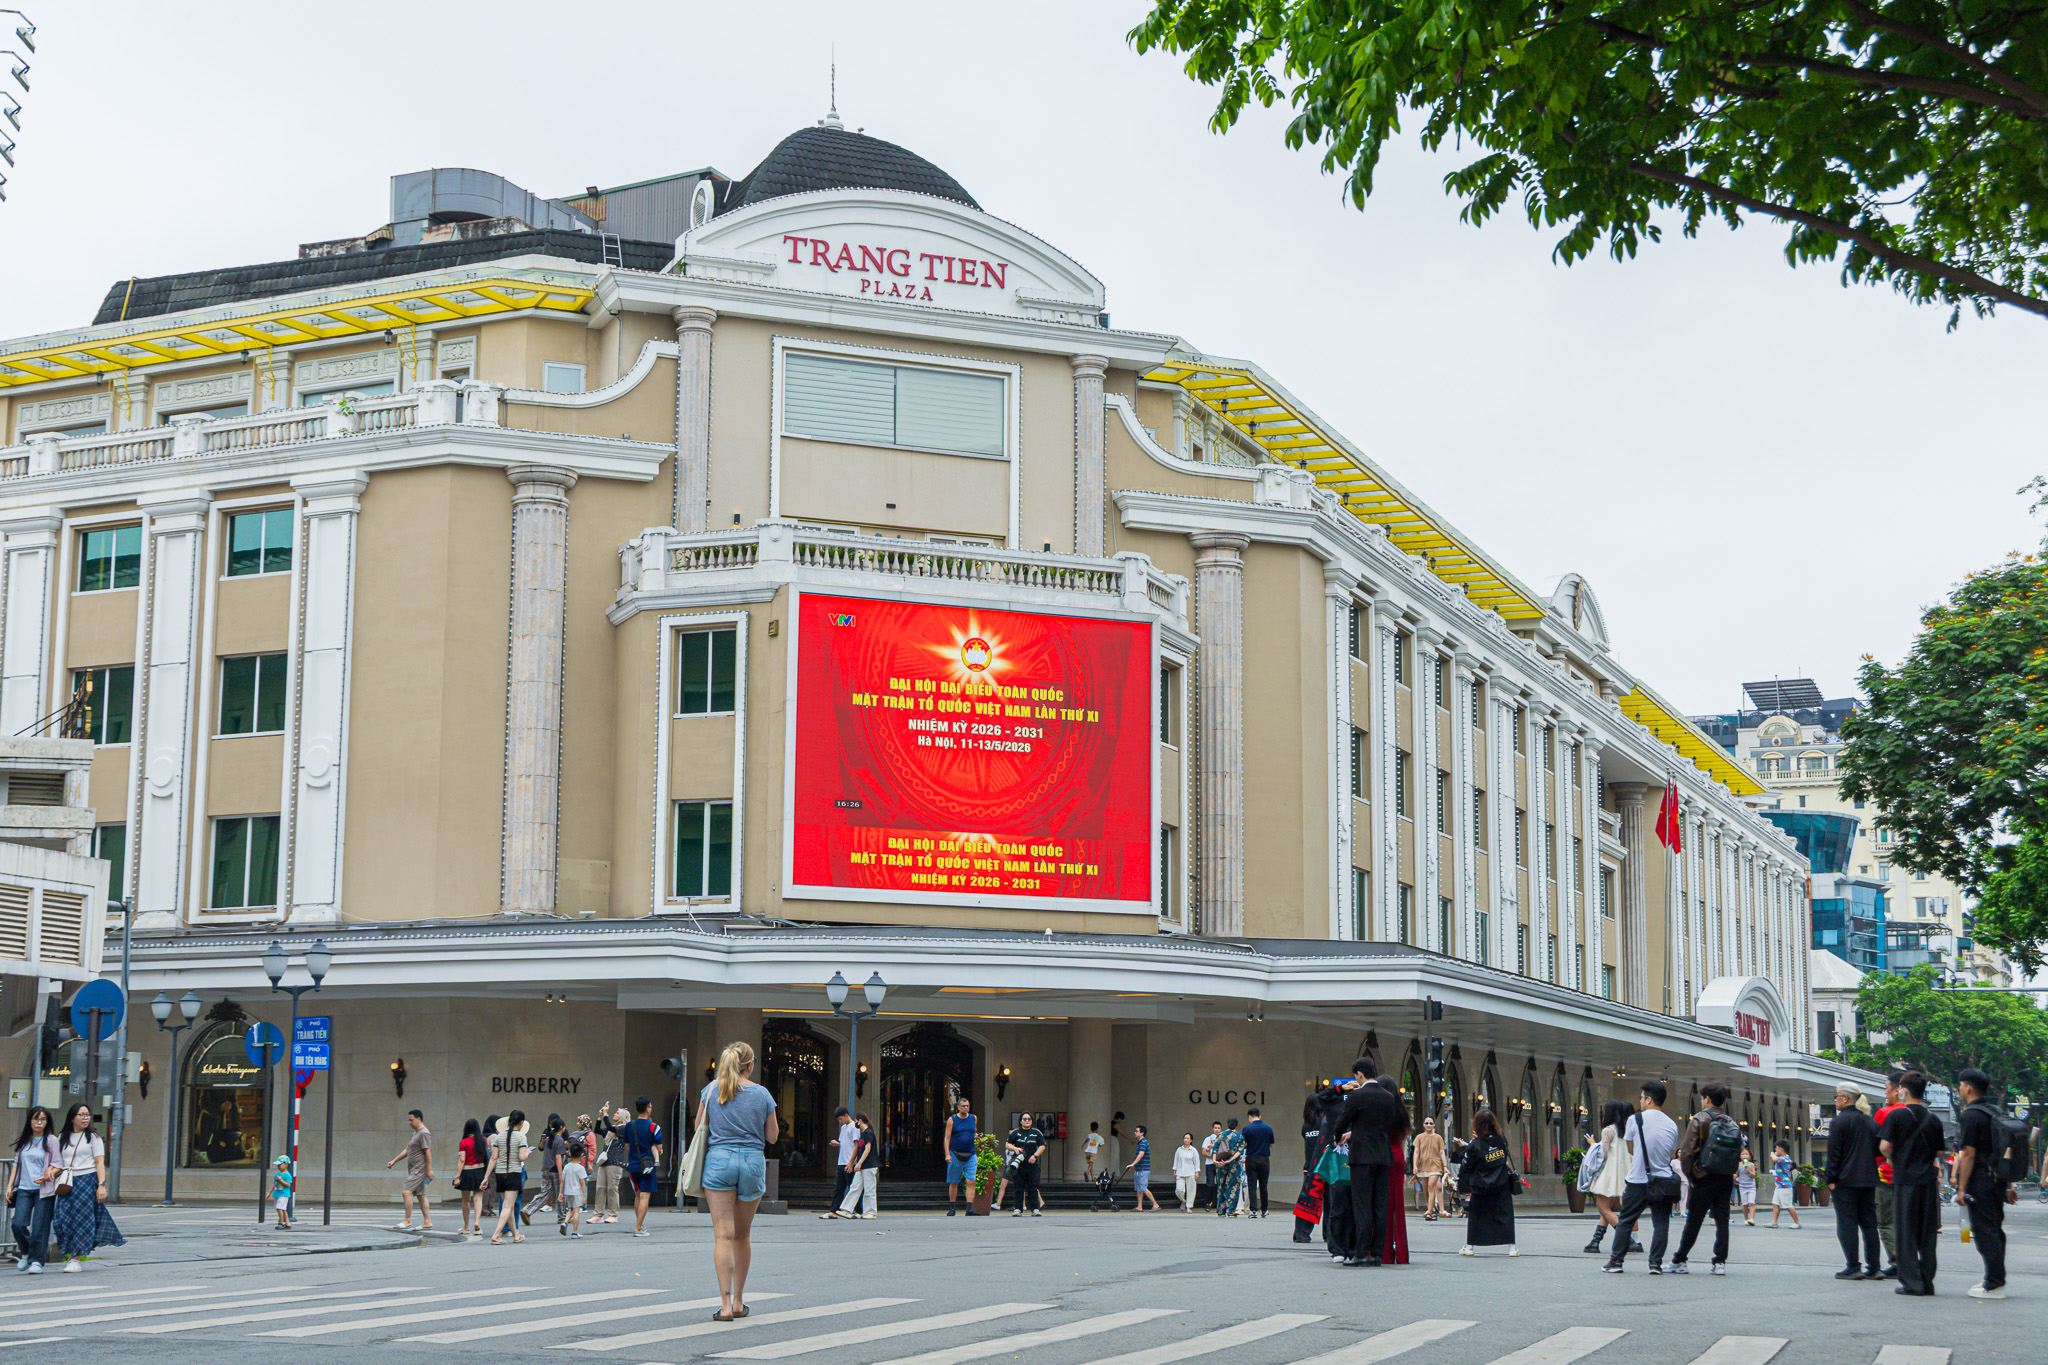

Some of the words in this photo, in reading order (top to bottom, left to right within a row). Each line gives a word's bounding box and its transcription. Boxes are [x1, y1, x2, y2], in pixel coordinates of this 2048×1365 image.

[783, 235, 911, 277] TRANG
[920, 253, 1008, 289] TIEN
[861, 279, 933, 301] PLAZA
[890, 677, 911, 692] ĐẠI
[914, 678, 936, 694] HỘI
[940, 681, 961, 695] ĐẠI
[966, 681, 992, 697] BIỂU
[997, 685, 1027, 699] TOÀN
[1032, 686, 1064, 702] QUỐC
[852, 692, 878, 708] MẶT
[882, 695, 914, 710] TRẬN
[918, 695, 933, 710] TỔ
[938, 698, 971, 713] QUỐC
[975, 702, 1001, 717] VIỆT
[1005, 705, 1031, 718] NAM
[1035, 704, 1056, 719] LẦN
[1060, 708, 1084, 721] THỨ
[1087, 710, 1098, 722] XI
[908, 718, 948, 733] NHIỆM
[952, 720, 968, 733] KỲ
[971, 723, 1001, 736] 2026
[1015, 726, 1043, 738] 2031
[918, 736, 931, 746] Hà
[935, 737, 956, 749] Nội,
[961, 739, 1031, 752] 11-13/5/2026
[888, 838, 909, 850] ĐẠI
[914, 838, 935, 852] HỘI
[939, 841, 959, 853] ĐẠI
[964, 839, 991, 853] BIỂU
[996, 843, 1026, 855] TOÀN
[1030, 843, 1063, 857] QUỐC
[851, 851, 877, 866] MẶT
[881, 853, 912, 867] TRẬN
[917, 853, 932, 867] TỔ
[937, 855, 970, 869] QUỐC
[974, 858, 1000, 872] VIỆT
[1004, 860, 1030, 872] NAM
[1034, 859, 1055, 873] LẦN
[1060, 863, 1084, 875] THỨ
[1086, 865, 1098, 876] XI
[912, 872, 948, 886] NHIỆM
[952, 874, 966, 886] KỲ
[970, 876, 1000, 888] 2026
[1012, 878, 1040, 889] 2031
[492, 1077, 581, 1093] BURBERRY
[1189, 1090, 1264, 1105] GUCCI
